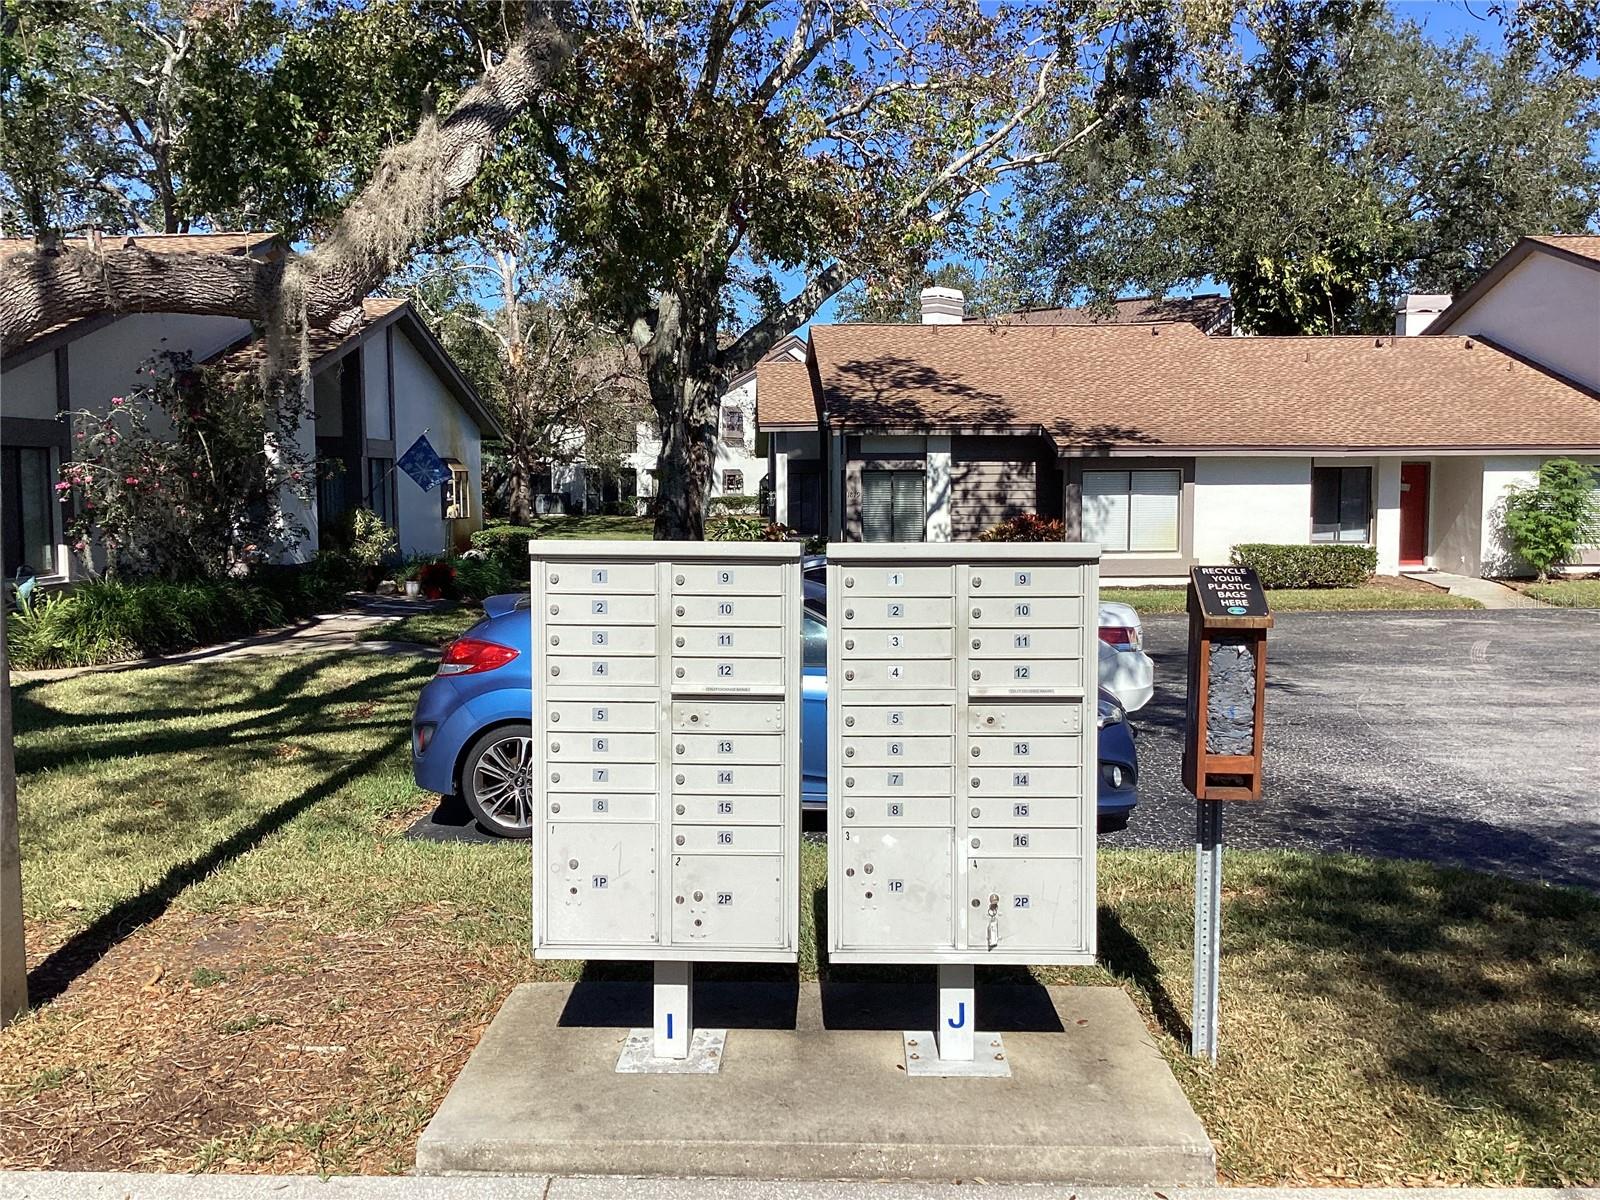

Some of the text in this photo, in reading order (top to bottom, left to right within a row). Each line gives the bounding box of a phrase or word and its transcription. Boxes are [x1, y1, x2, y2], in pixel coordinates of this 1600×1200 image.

[722, 572, 729, 583] 9
[1019, 574, 1027, 585] 9
[596, 602, 604, 613] 2
[719, 604, 732, 615] 10
[892, 605, 899, 616] 2
[1016, 605, 1029, 616] 10
[596, 633, 604, 644] 3
[719, 634, 731, 645] 11
[892, 636, 899, 647] 3
[1016, 636, 1027, 647] 11
[596, 664, 604, 675] 4
[718, 665, 732, 676] 12
[891, 667, 899, 678] 4
[1015, 667, 1028, 678] 12
[597, 710, 604, 720] 5
[892, 713, 899, 724] 5
[597, 739, 604, 750] 6
[719, 742, 732, 752] 13
[891, 744, 899, 754] 6
[1015, 743, 1028, 754] 13
[597, 770, 604, 780] 7
[719, 772, 731, 783] 14
[892, 774, 899, 785] 7
[1015, 775, 1028, 785] 14
[597, 800, 604, 811] 8
[719, 802, 732, 813] 15
[891, 805, 899, 815] 8
[1014, 805, 1028, 816] 15
[719, 833, 732, 844] 16
[1014, 836, 1027, 846] 16
[593, 877, 607, 888] 1P
[889, 881, 903, 892] 1P
[718, 894, 732, 905] 2P
[1015, 897, 1029, 907] 2P
[948, 1002, 964, 1028] J
[667, 1013, 673, 1039] I
